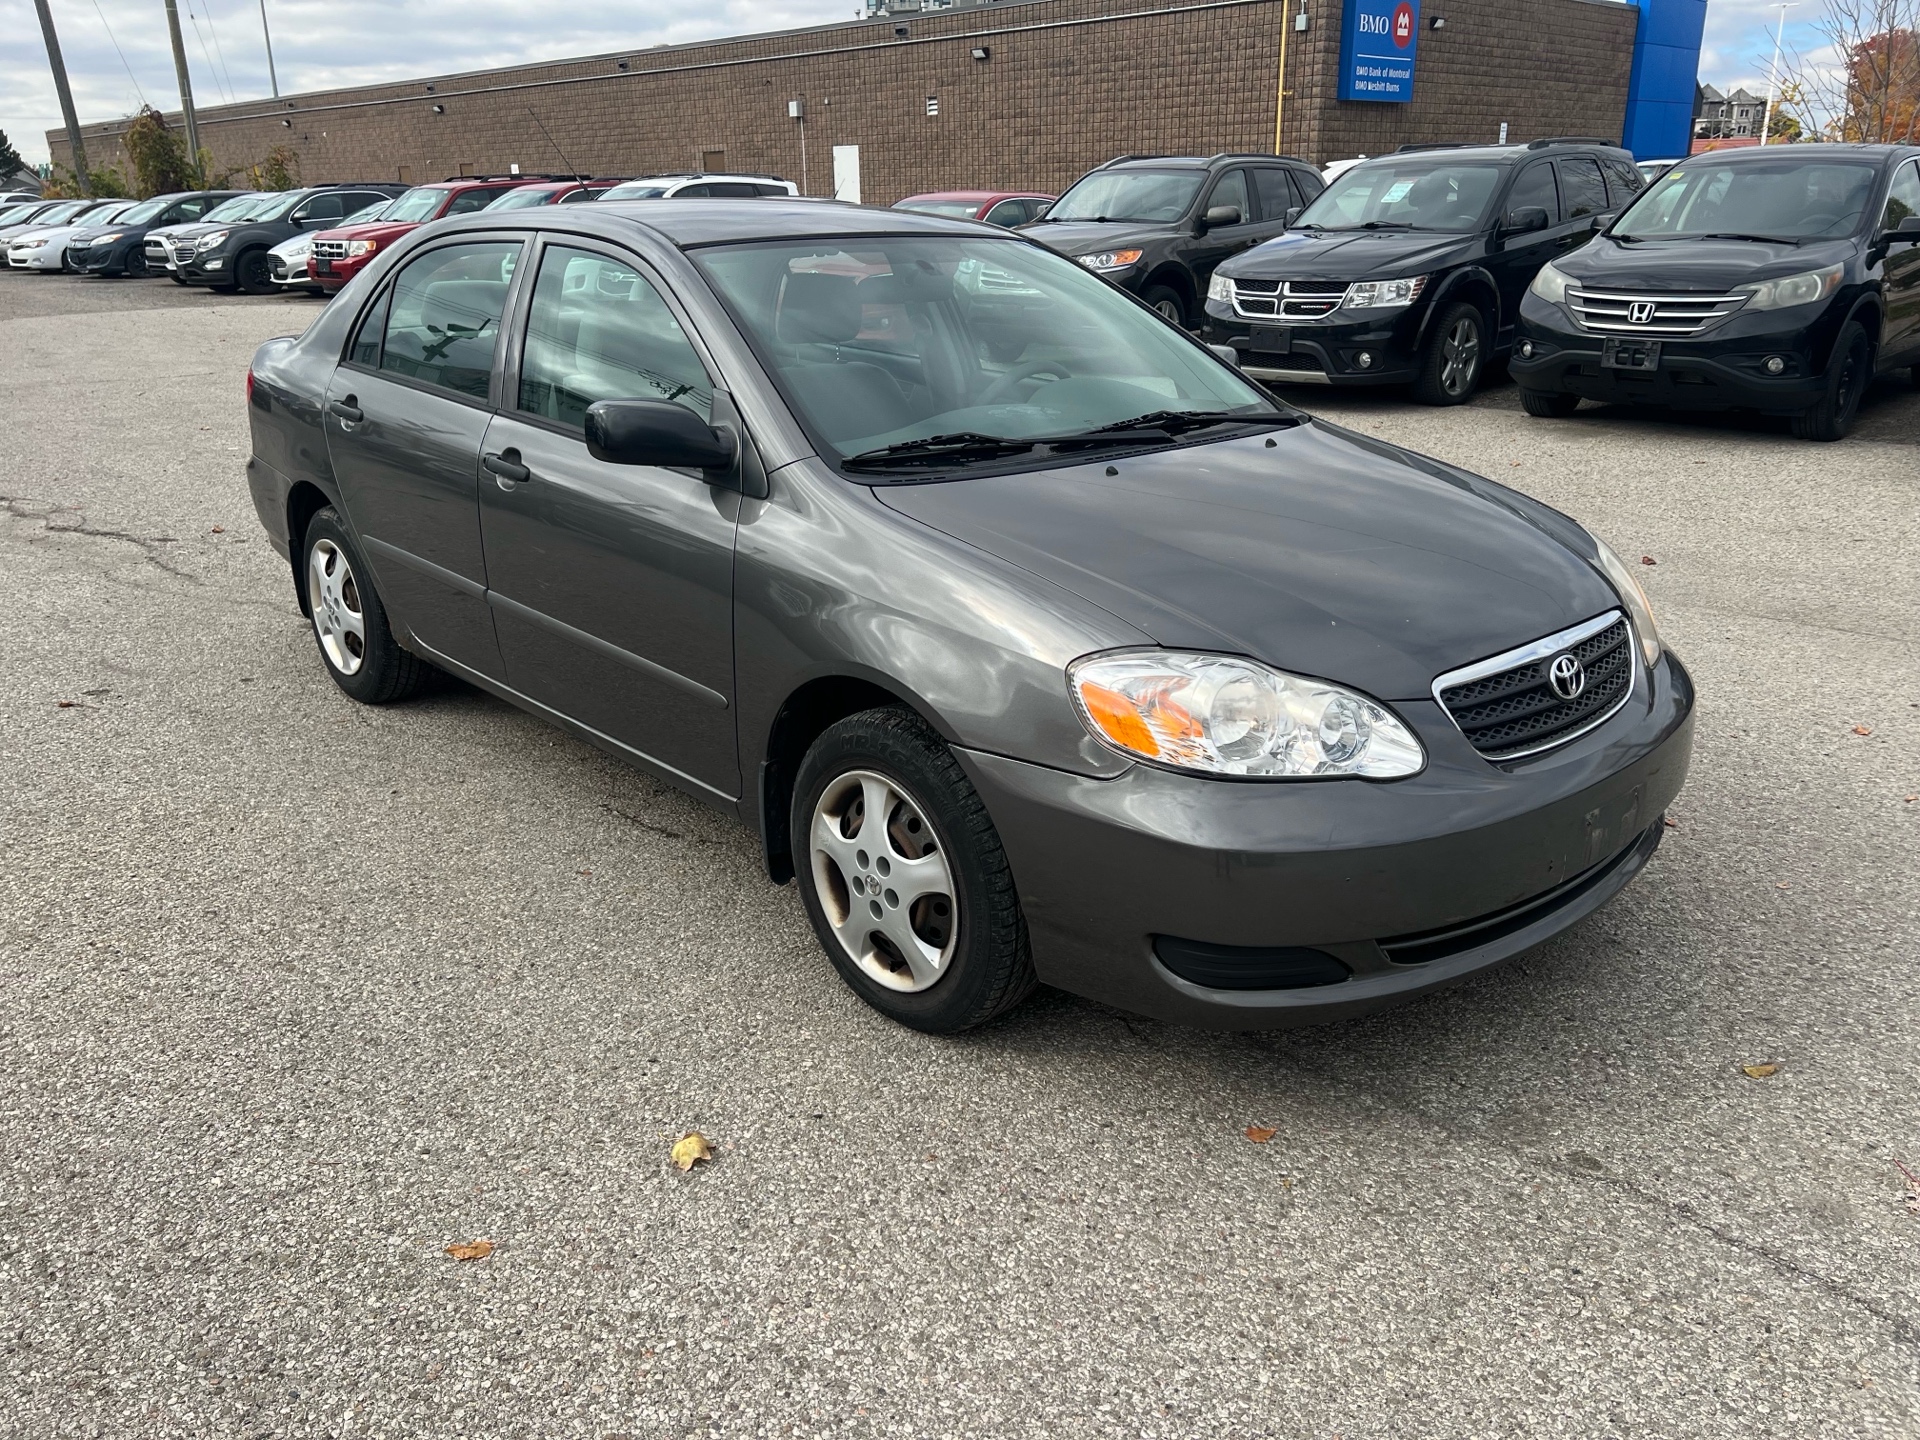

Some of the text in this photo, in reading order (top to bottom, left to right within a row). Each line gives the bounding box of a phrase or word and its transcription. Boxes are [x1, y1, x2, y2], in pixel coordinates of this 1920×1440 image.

[1359, 13, 1390, 35] BMO
[1356, 66, 1410, 78] BMO Bank of Montreal
[1355, 80, 1367, 90] BMO
[1386, 82, 1399, 92] Burns
